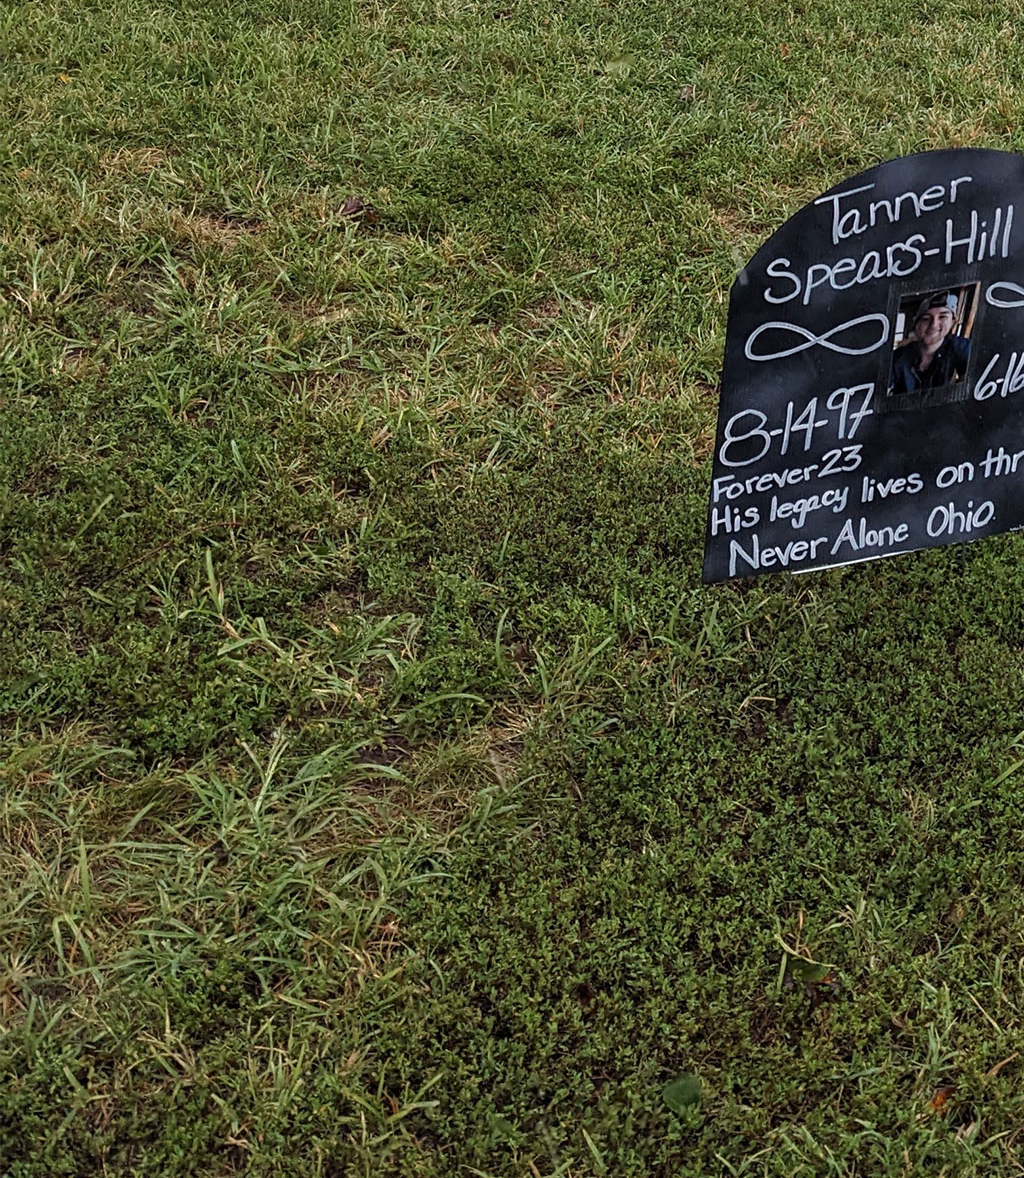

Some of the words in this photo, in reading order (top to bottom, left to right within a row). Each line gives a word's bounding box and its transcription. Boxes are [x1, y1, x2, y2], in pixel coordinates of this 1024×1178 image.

[814, 175, 973, 245] Tanner
[763, 204, 1015, 306] Spears-Hill
[719, 382, 876, 468] 8-14-97
[711, 506, 761, 536] His
[769, 483, 849, 530] legacy
[862, 472, 924, 502] lives
[936, 461, 974, 489] on
[727, 535, 828, 577] Never
[831, 517, 910, 555] Alone
